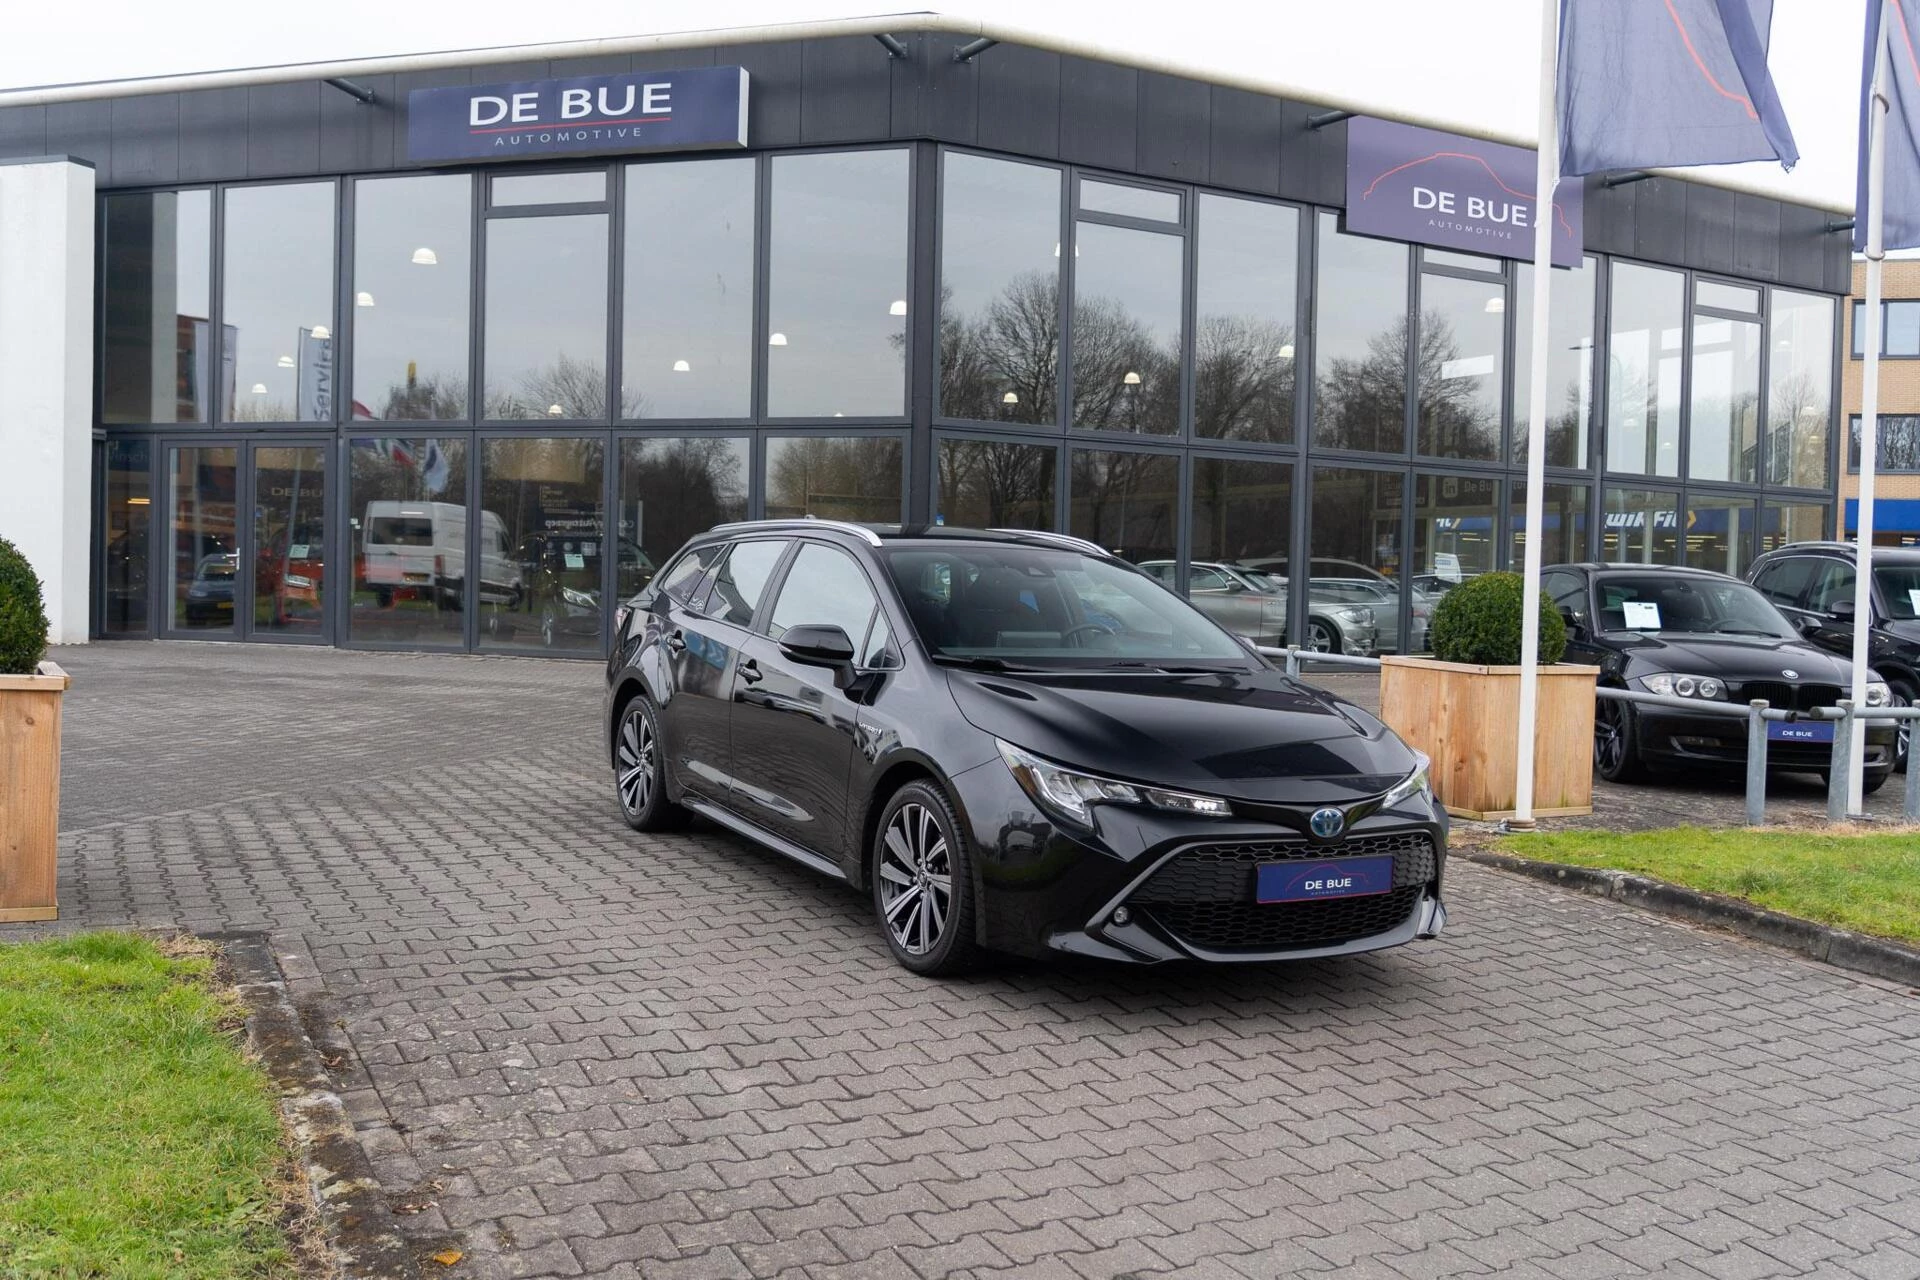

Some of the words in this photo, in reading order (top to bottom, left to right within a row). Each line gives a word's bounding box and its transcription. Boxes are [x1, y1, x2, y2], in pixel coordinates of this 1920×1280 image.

[470, 92, 539, 126] DE
[561, 83, 672, 119] BUE
[495, 127, 641, 147] AUTOMOTIVE
[1412, 186, 1455, 214] DE
[1467, 196, 1528, 227] BUE
[1428, 219, 1513, 240] AUTOMOTIVE
[1305, 880, 1323, 890] DE
[1327, 878, 1352, 889] BUE
